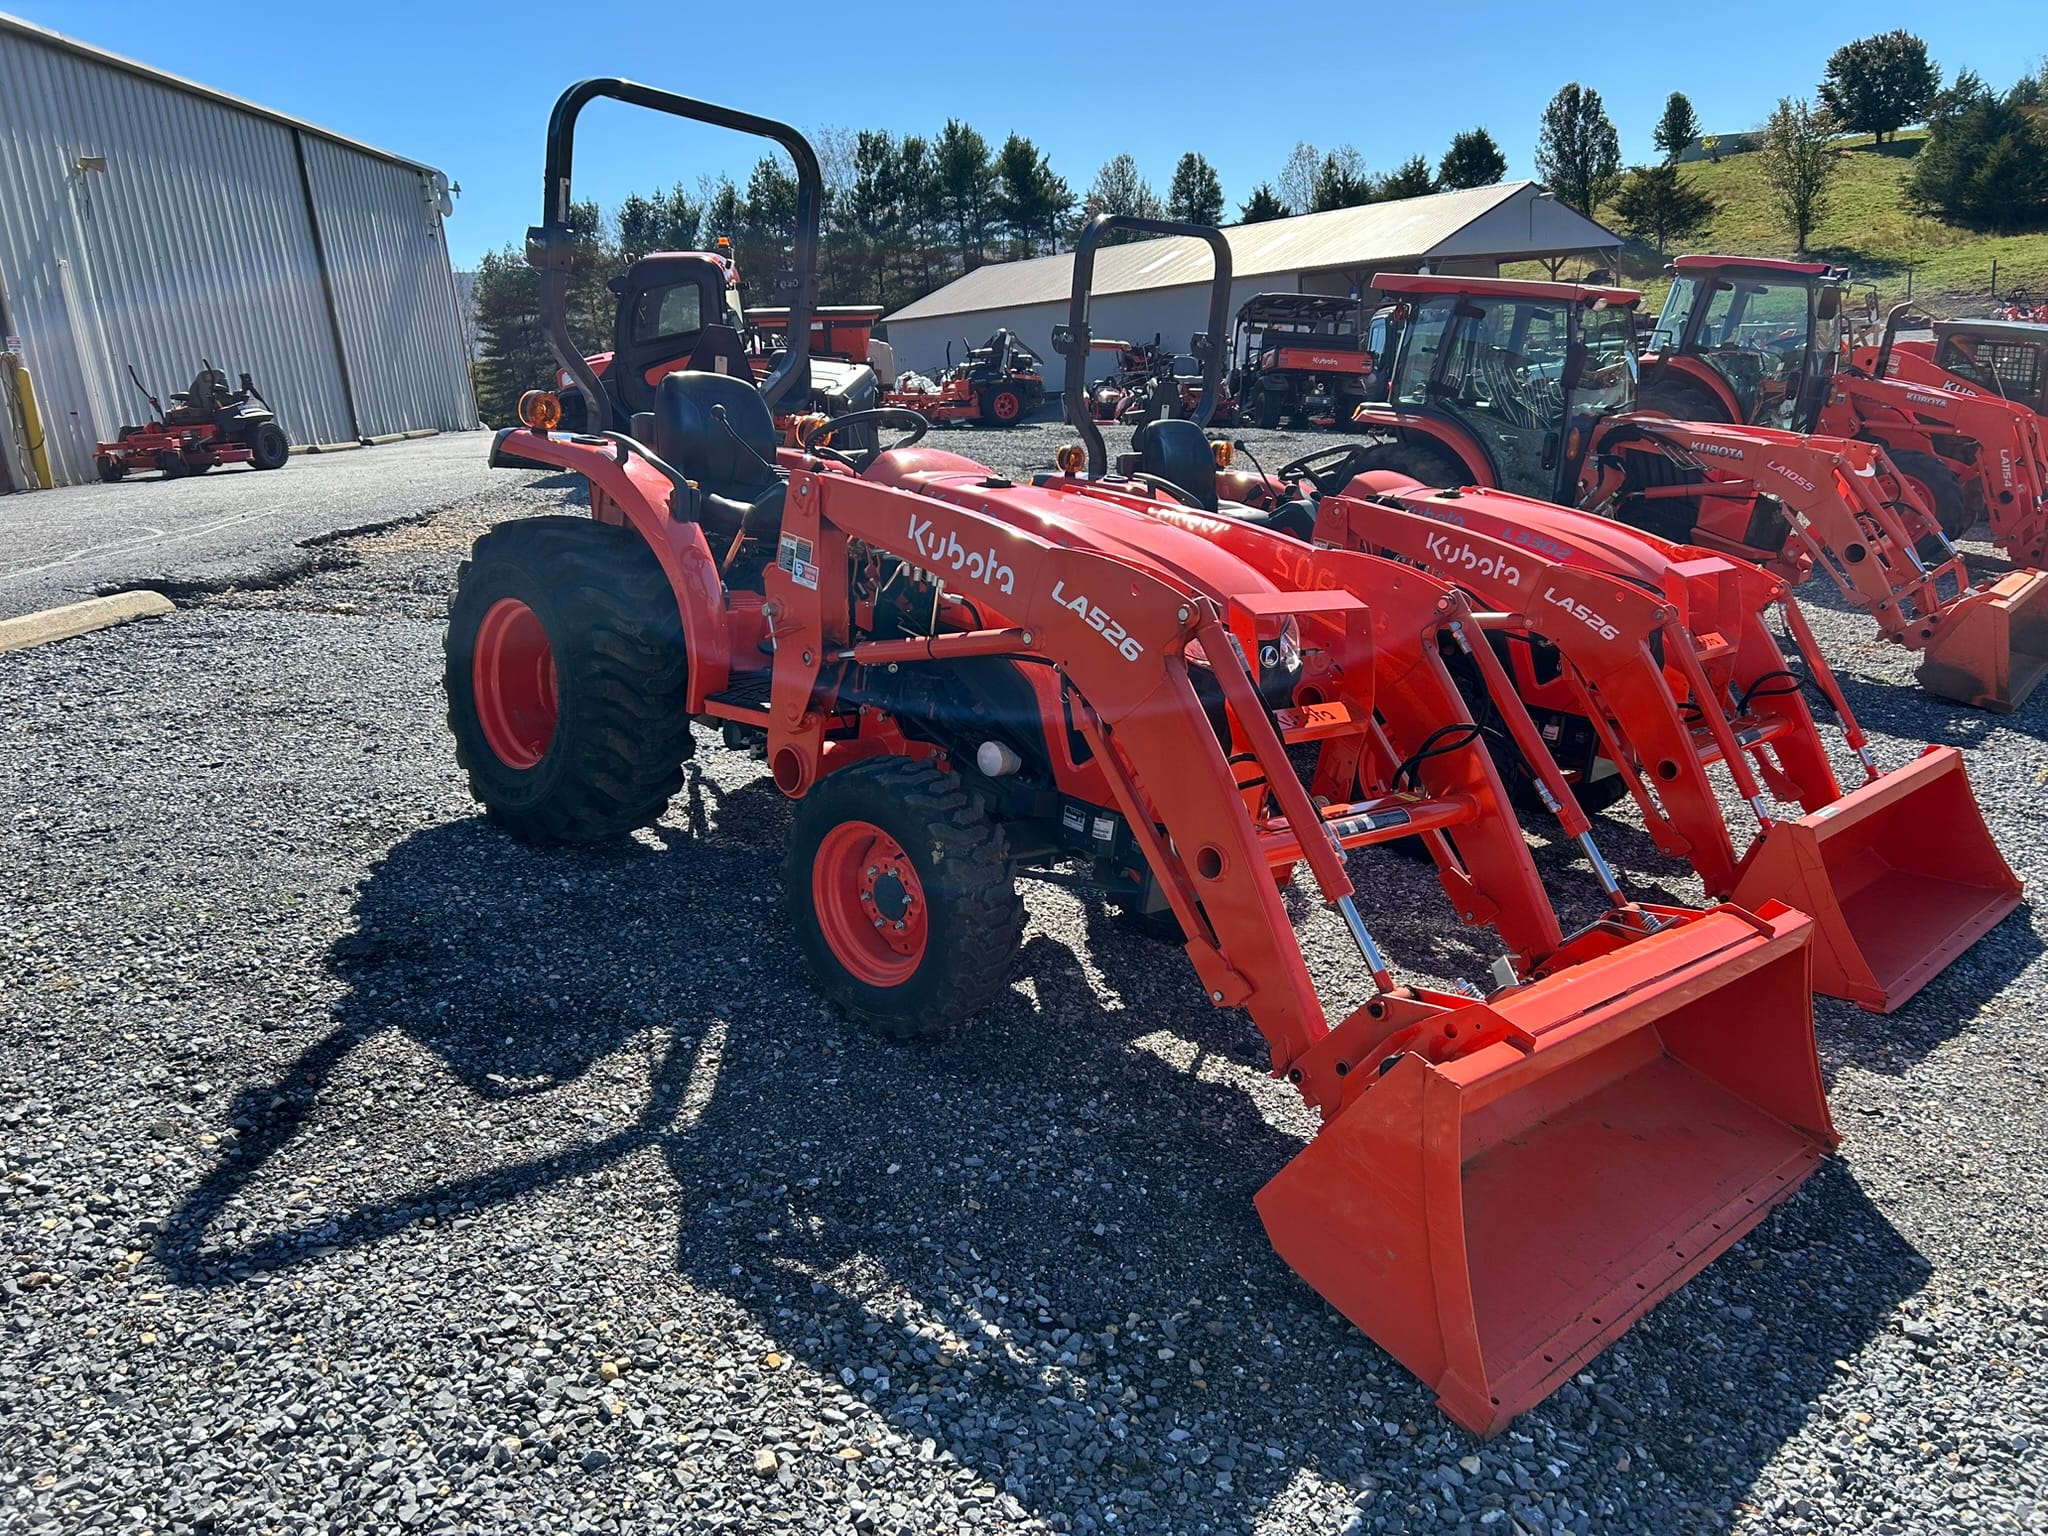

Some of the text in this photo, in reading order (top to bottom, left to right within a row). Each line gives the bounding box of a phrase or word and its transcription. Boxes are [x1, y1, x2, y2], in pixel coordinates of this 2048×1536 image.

[1312, 356, 1338, 366] Kubota
[1905, 391, 1948, 408] KUBOTA
[1690, 440, 1744, 460] KUBOTA
[1767, 460, 1816, 492] LA1055
[2000, 449, 2012, 488] LA1154
[907, 513, 1015, 596] Kubota
[1425, 531, 1520, 587] Kubota
[1502, 527, 1572, 560] L3302
[1051, 580, 1145, 663] LA526
[1543, 586, 1620, 642] LA526
